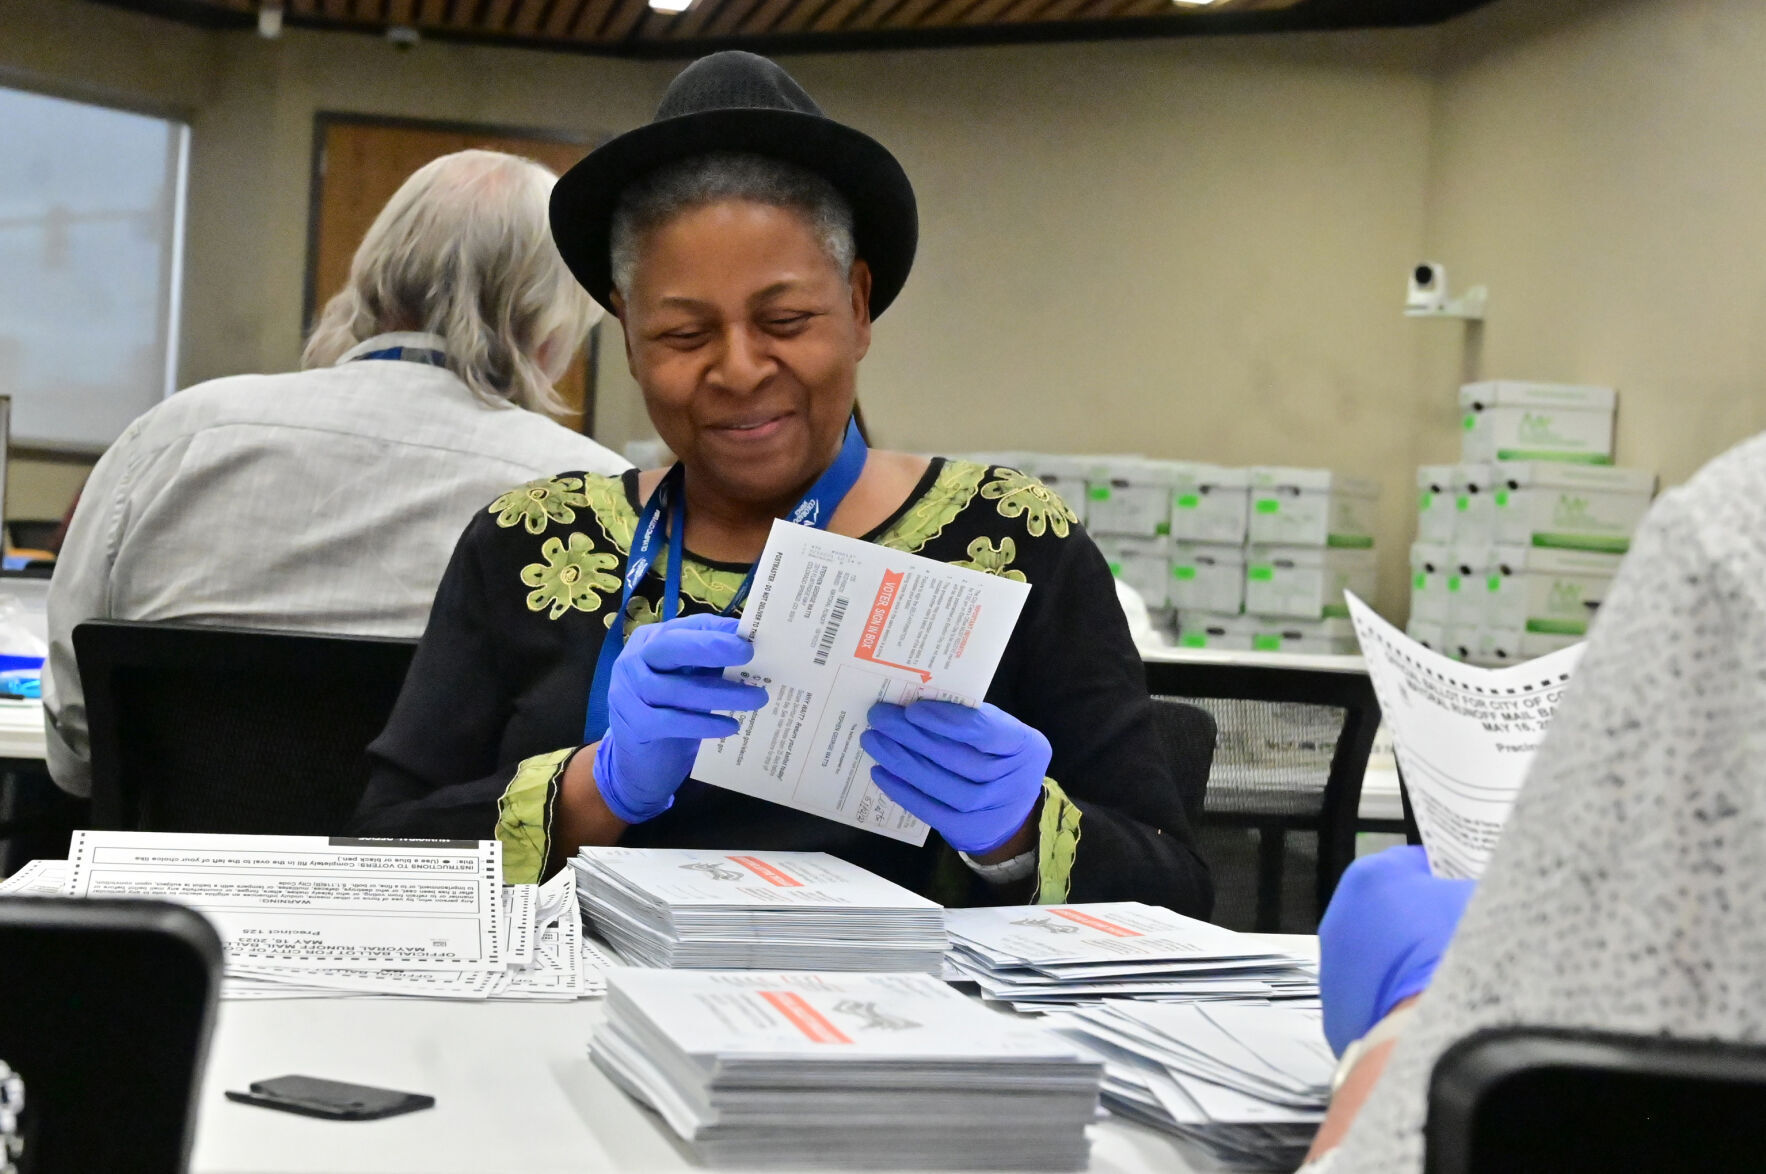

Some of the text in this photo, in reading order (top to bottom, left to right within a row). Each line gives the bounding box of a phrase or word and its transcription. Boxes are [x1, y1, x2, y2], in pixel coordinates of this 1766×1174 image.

[641, 529, 653, 552] OLYMPIC
[767, 551, 783, 582] POSTMASTER
[760, 591, 769, 601] NOT
[754, 601, 766, 620] DELIVER
[861, 580, 896, 649] VOTER, SIGN IN BOX
[803, 691, 812, 703] WHY
[1462, 695, 1487, 709] FOR
[1490, 698, 1519, 711] CITY
[1523, 697, 1542, 709] OF
[797, 704, 808, 720] WAIT?
[1452, 704, 1497, 721] RUNOFF
[1501, 712, 1534, 722] MAIL
[790, 721, 802, 739] Return
[1483, 721, 1511, 733] MAY
[785, 738, 794, 751] your
[1496, 742, 1540, 753] Precin
